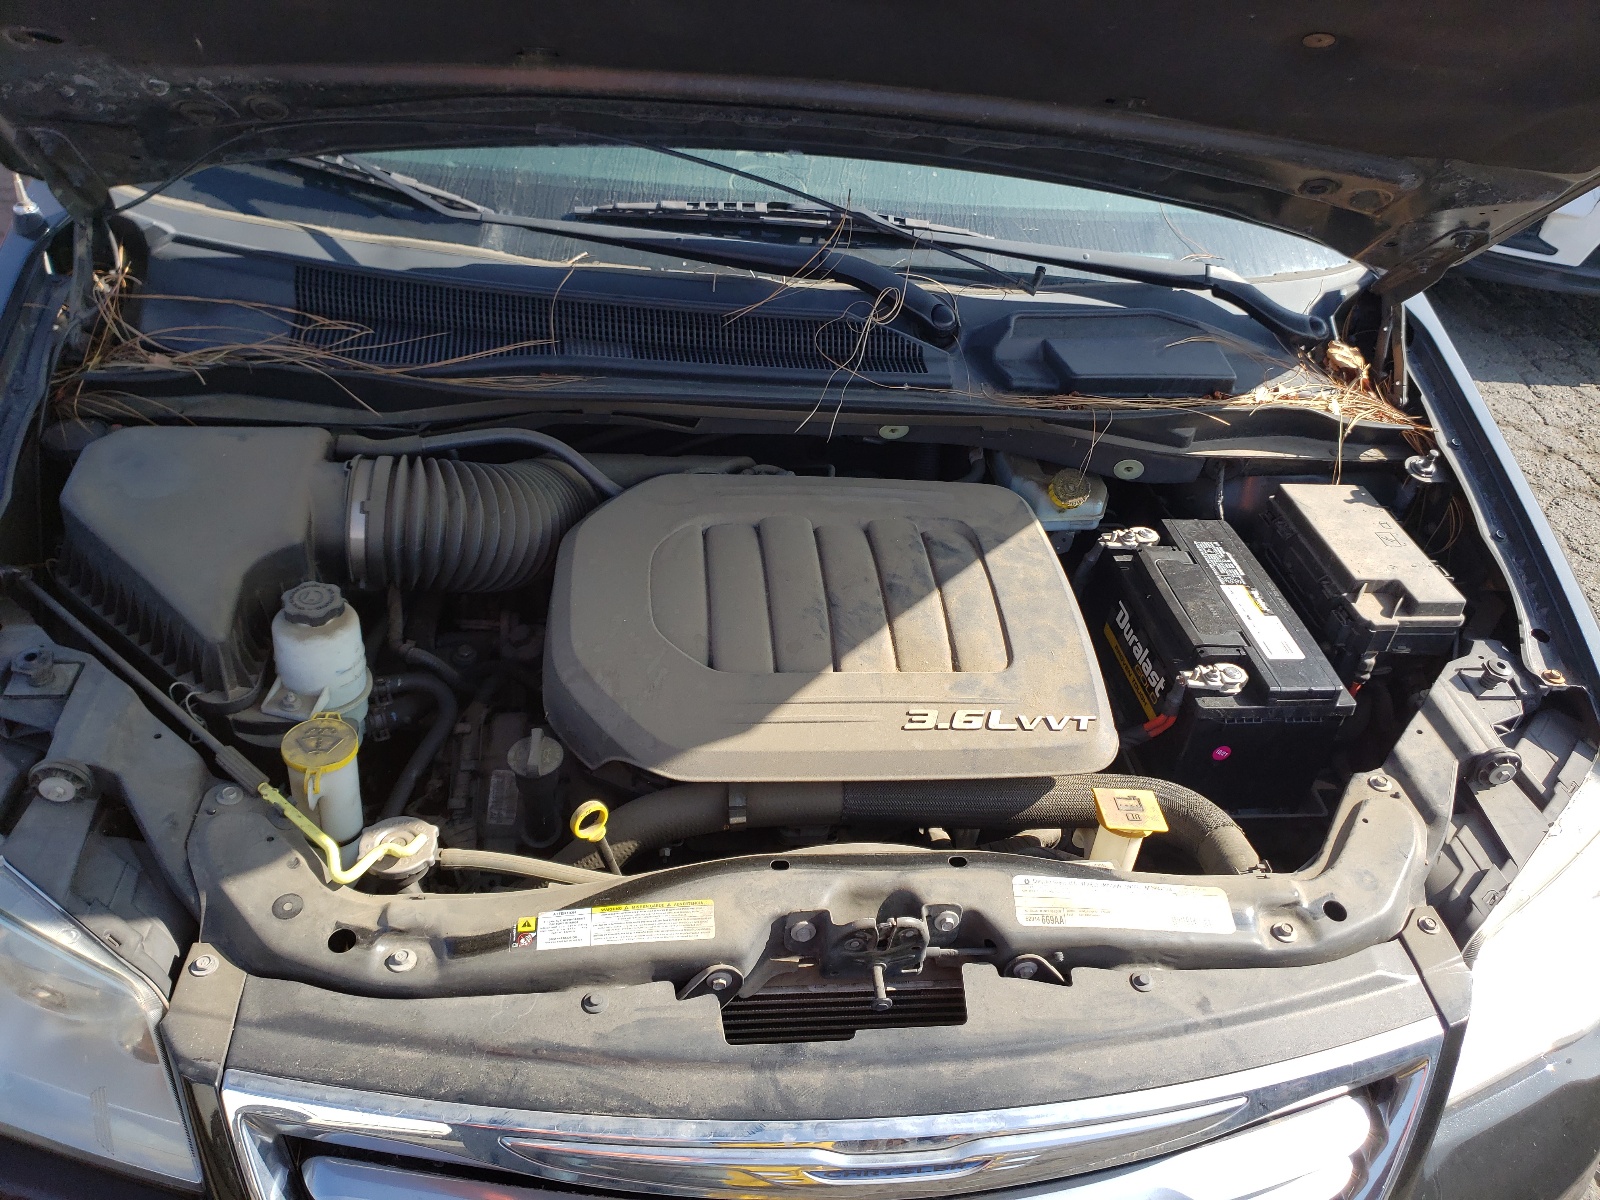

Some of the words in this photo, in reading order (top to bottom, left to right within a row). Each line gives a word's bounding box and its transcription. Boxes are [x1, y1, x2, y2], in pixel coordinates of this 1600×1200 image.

[1114, 645, 1133, 677] PROVEN
[1130, 677, 1148, 706] TOUGH
[1115, 600, 1166, 698] Duralast
[1134, 663, 1158, 705] GOLD
